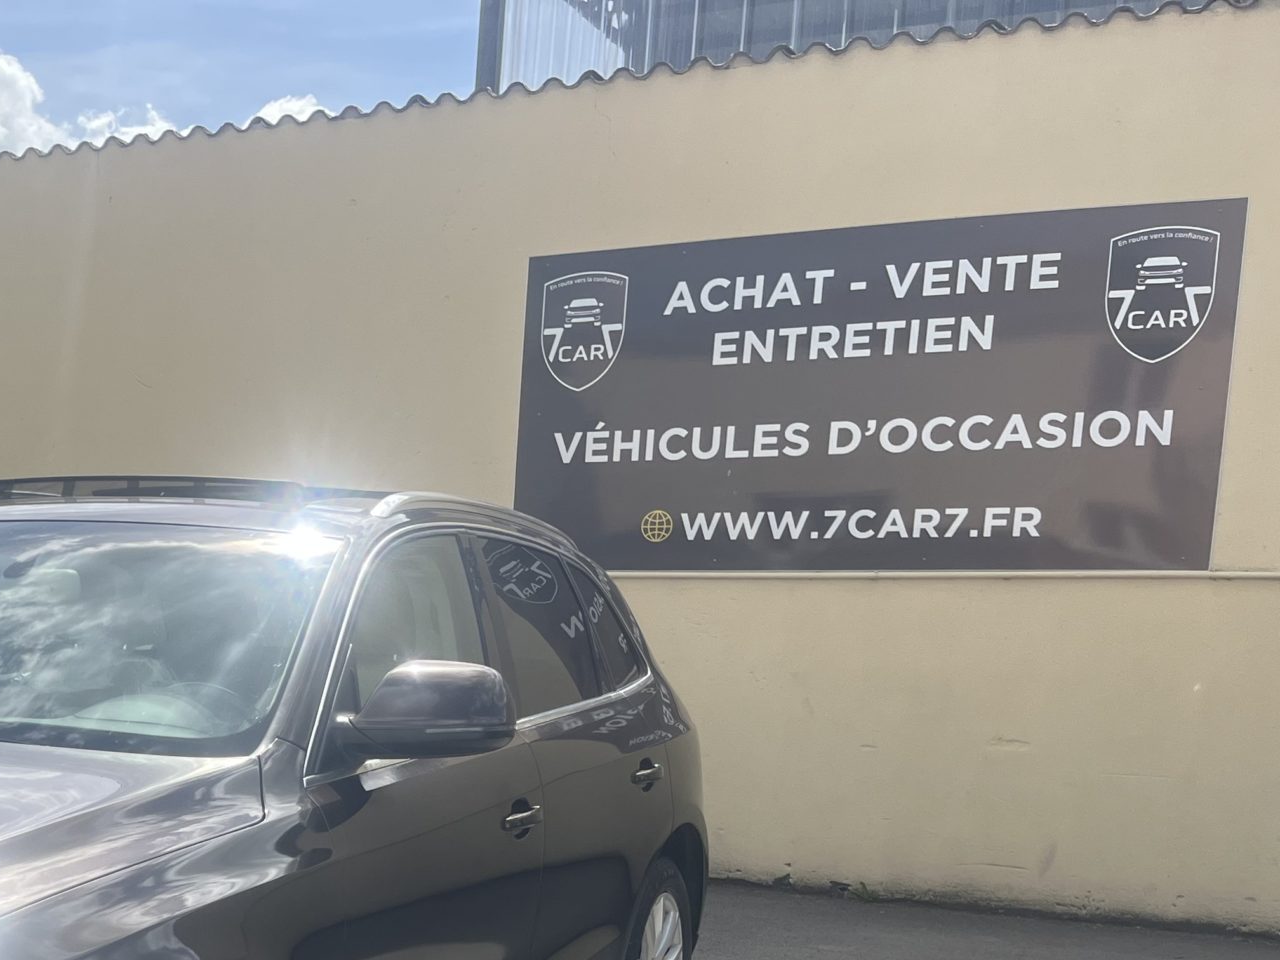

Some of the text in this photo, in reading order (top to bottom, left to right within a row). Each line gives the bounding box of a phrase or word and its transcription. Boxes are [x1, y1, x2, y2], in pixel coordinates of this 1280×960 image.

[1128, 235, 1149, 244] route
[1166, 231, 1174, 239] la
[1174, 232, 1209, 242] confiance
[663, 269, 835, 316] ACHAT
[885, 252, 1062, 299] VENTE
[712, 314, 995, 366] ENTRETIEN
[554, 409, 1174, 464] VÉHICULES D'OCCASION
[680, 506, 1042, 541] WWW.7CAR7.FR
